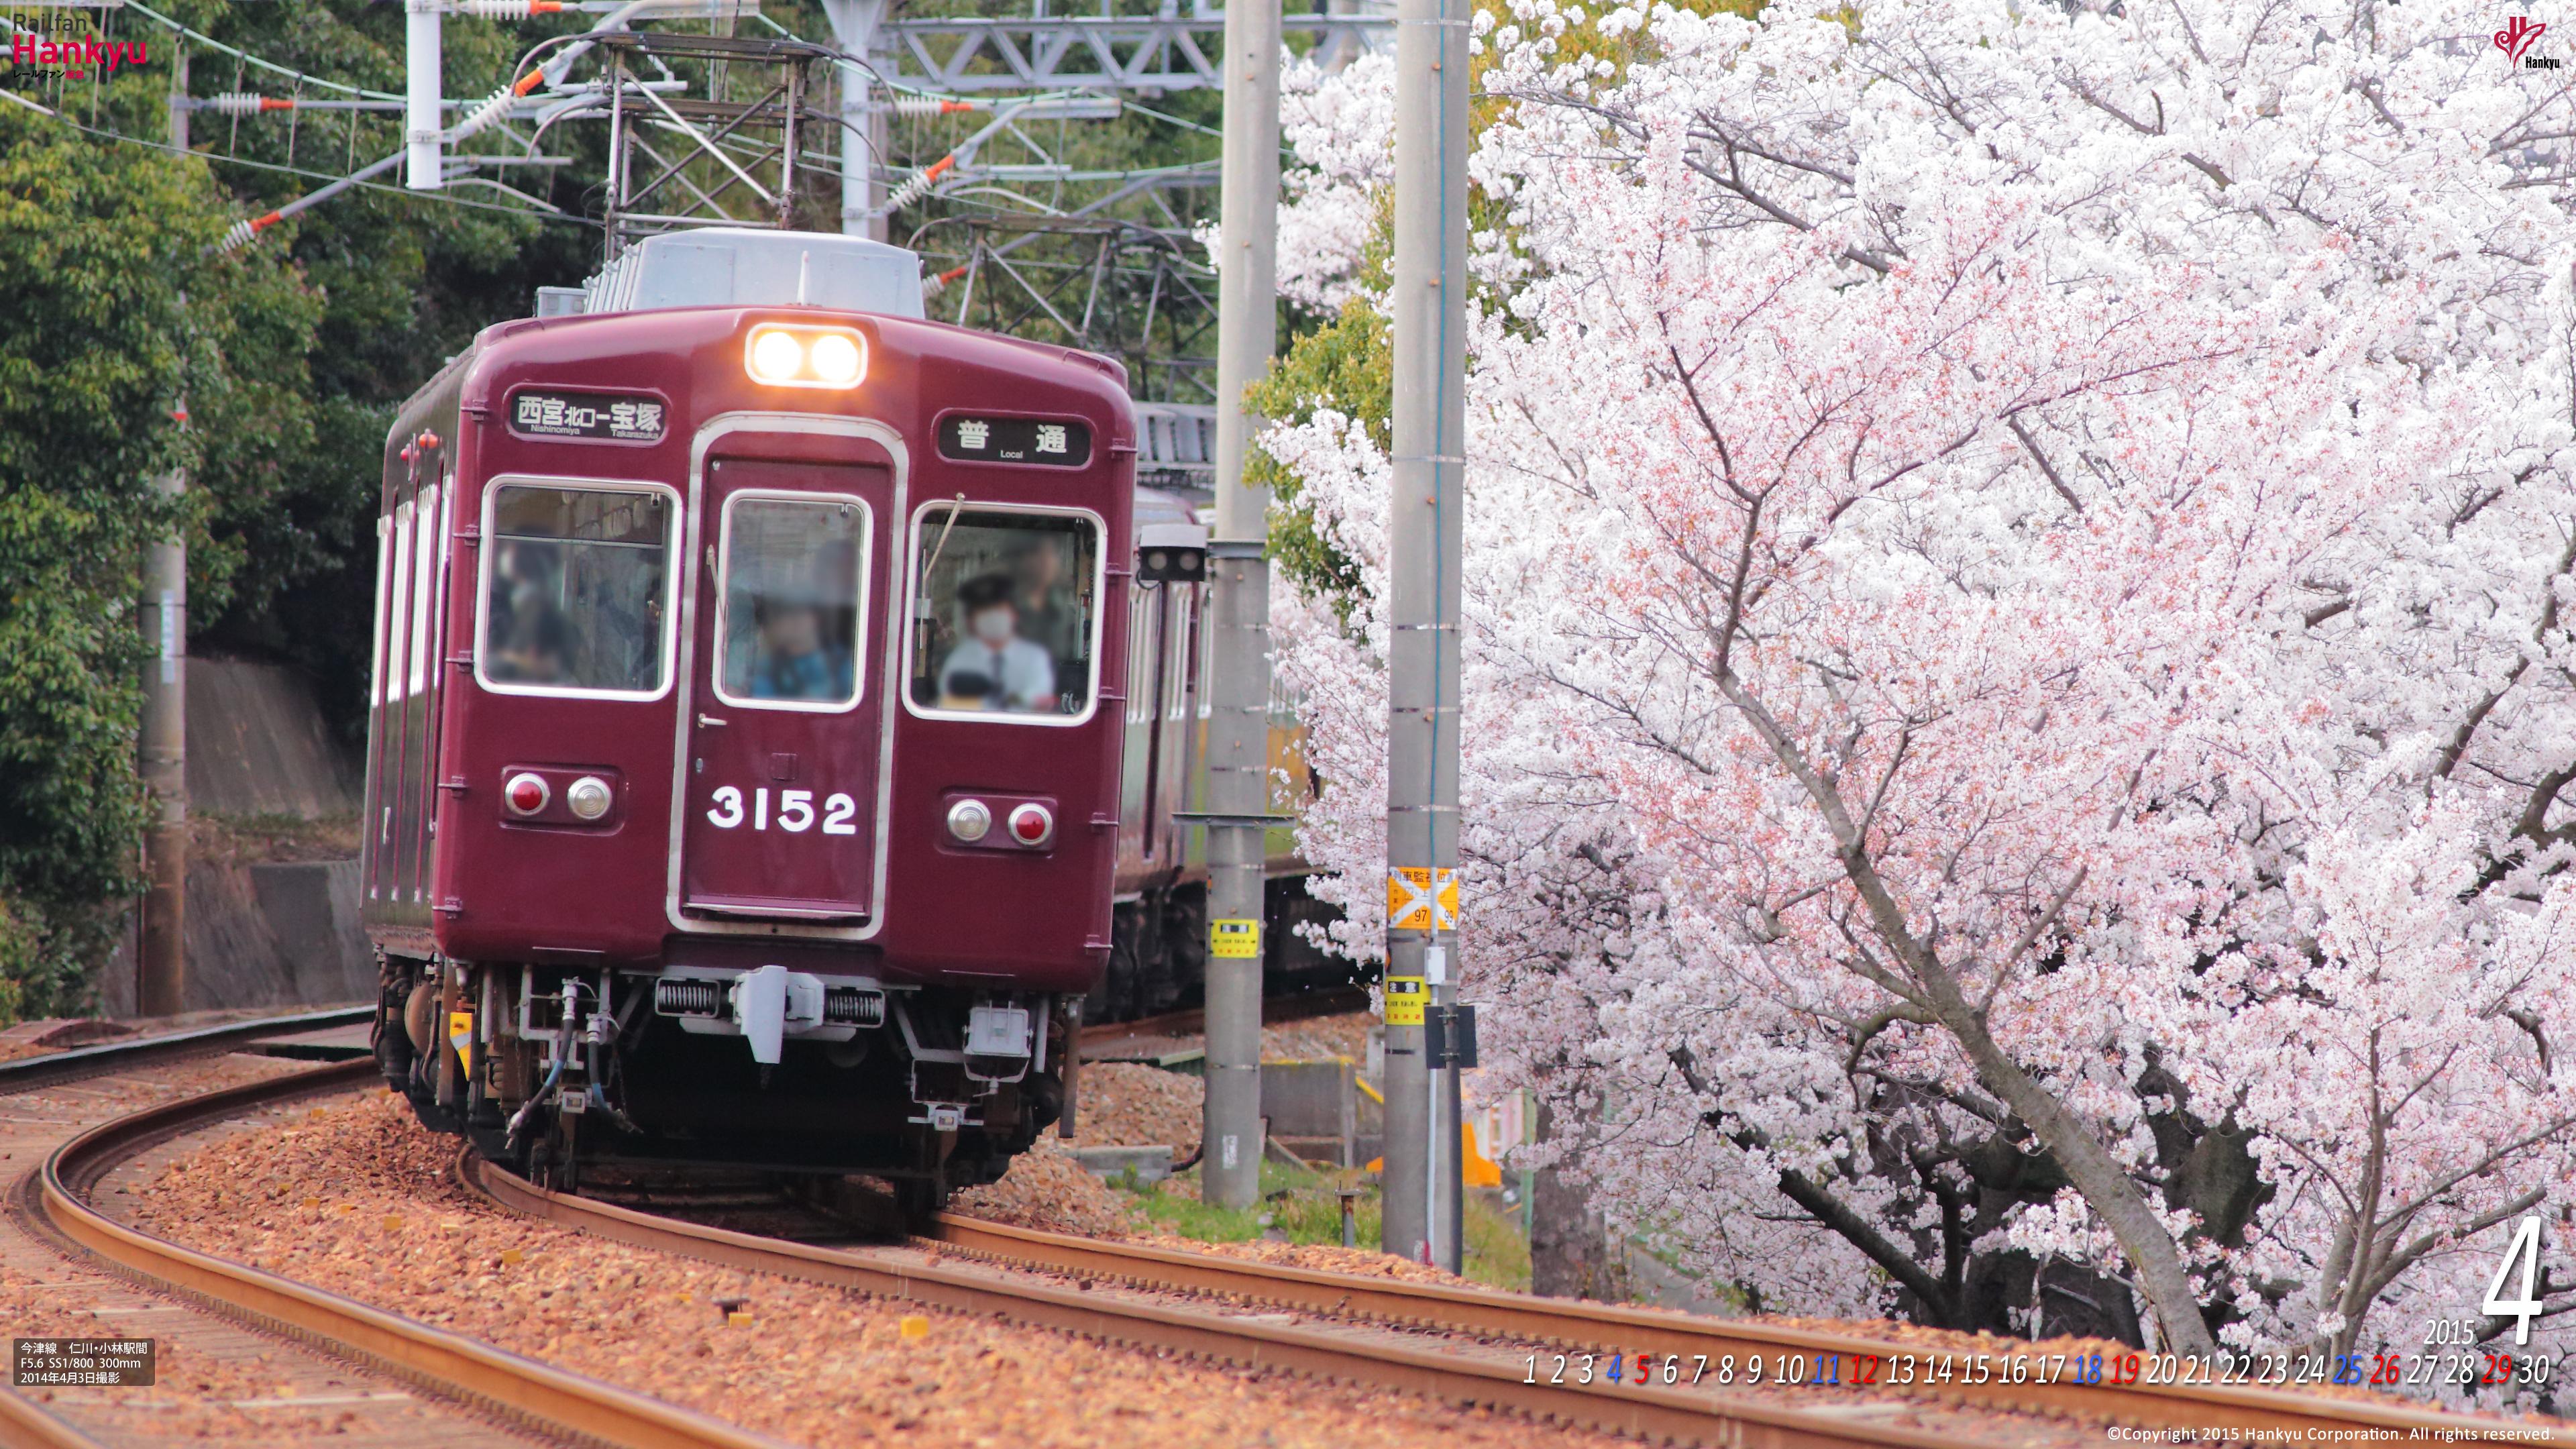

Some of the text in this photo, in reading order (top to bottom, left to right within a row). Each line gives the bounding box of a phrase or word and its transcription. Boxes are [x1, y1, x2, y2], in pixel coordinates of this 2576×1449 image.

[531, 425, 659, 439] Nishinomiya Takarazuka
[1000, 450, 1023, 459] Local
[706, 786, 856, 835] 3152
[1415, 909, 1428, 922] 97
